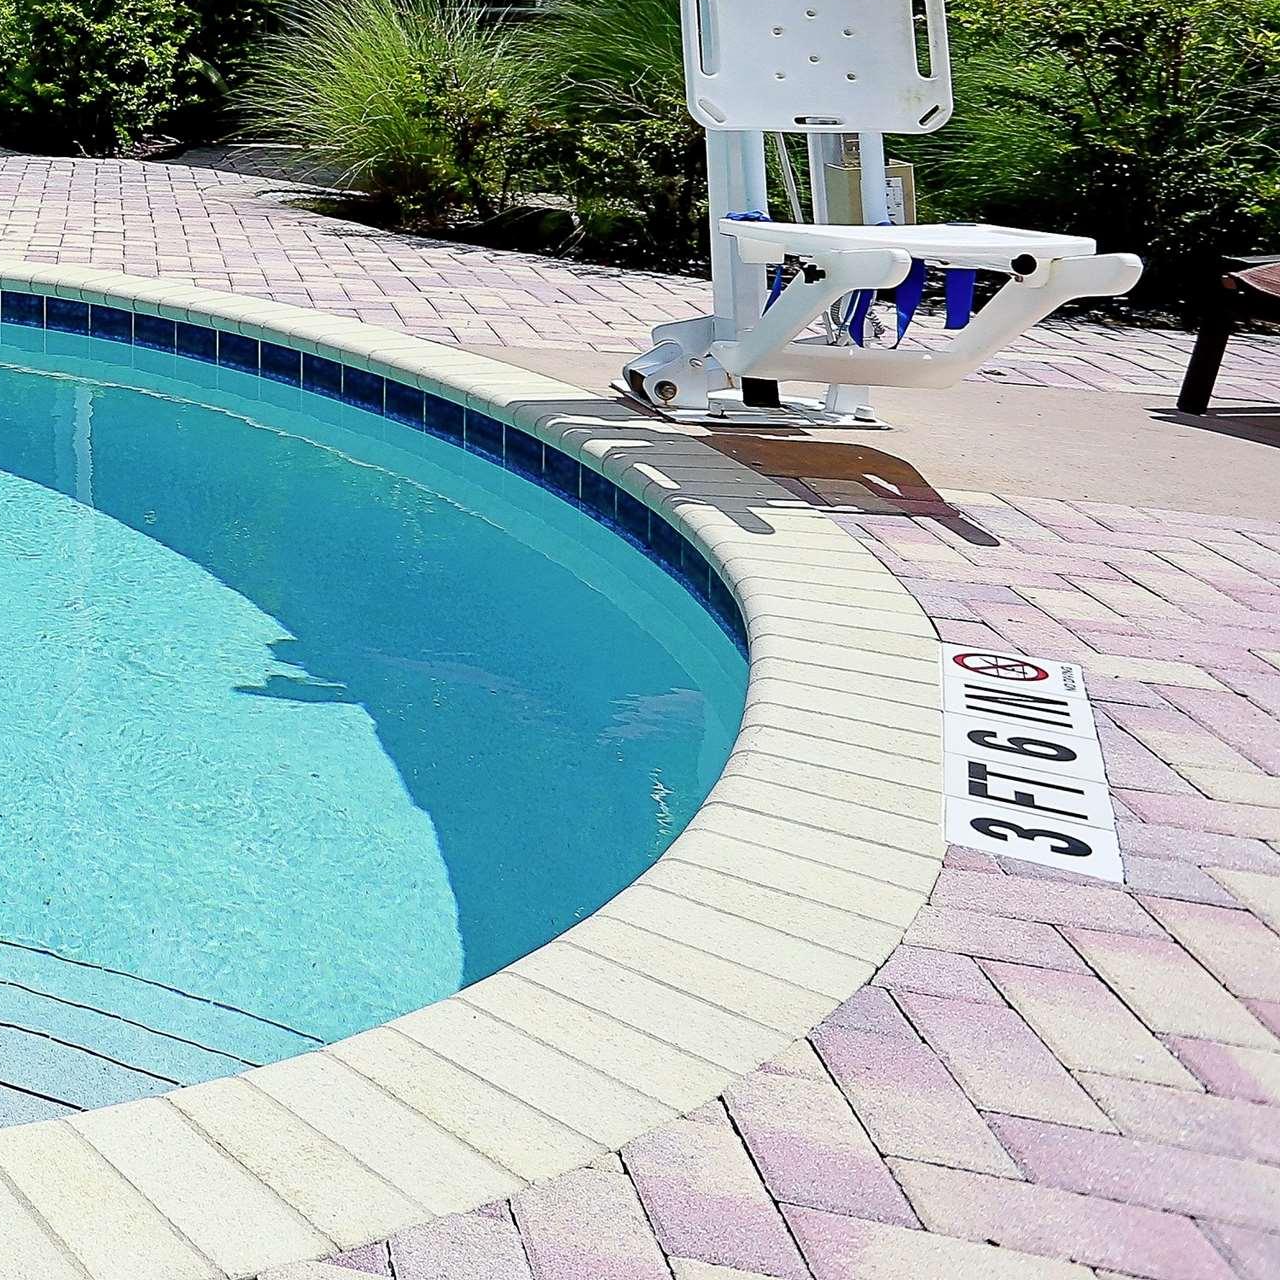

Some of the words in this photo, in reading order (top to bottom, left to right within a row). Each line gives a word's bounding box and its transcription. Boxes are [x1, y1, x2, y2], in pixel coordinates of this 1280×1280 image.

[963, 683, 1074, 729] IN
[966, 729, 1078, 762] 6
[967, 760, 1089, 821] FT
[969, 817, 1093, 857] 3
